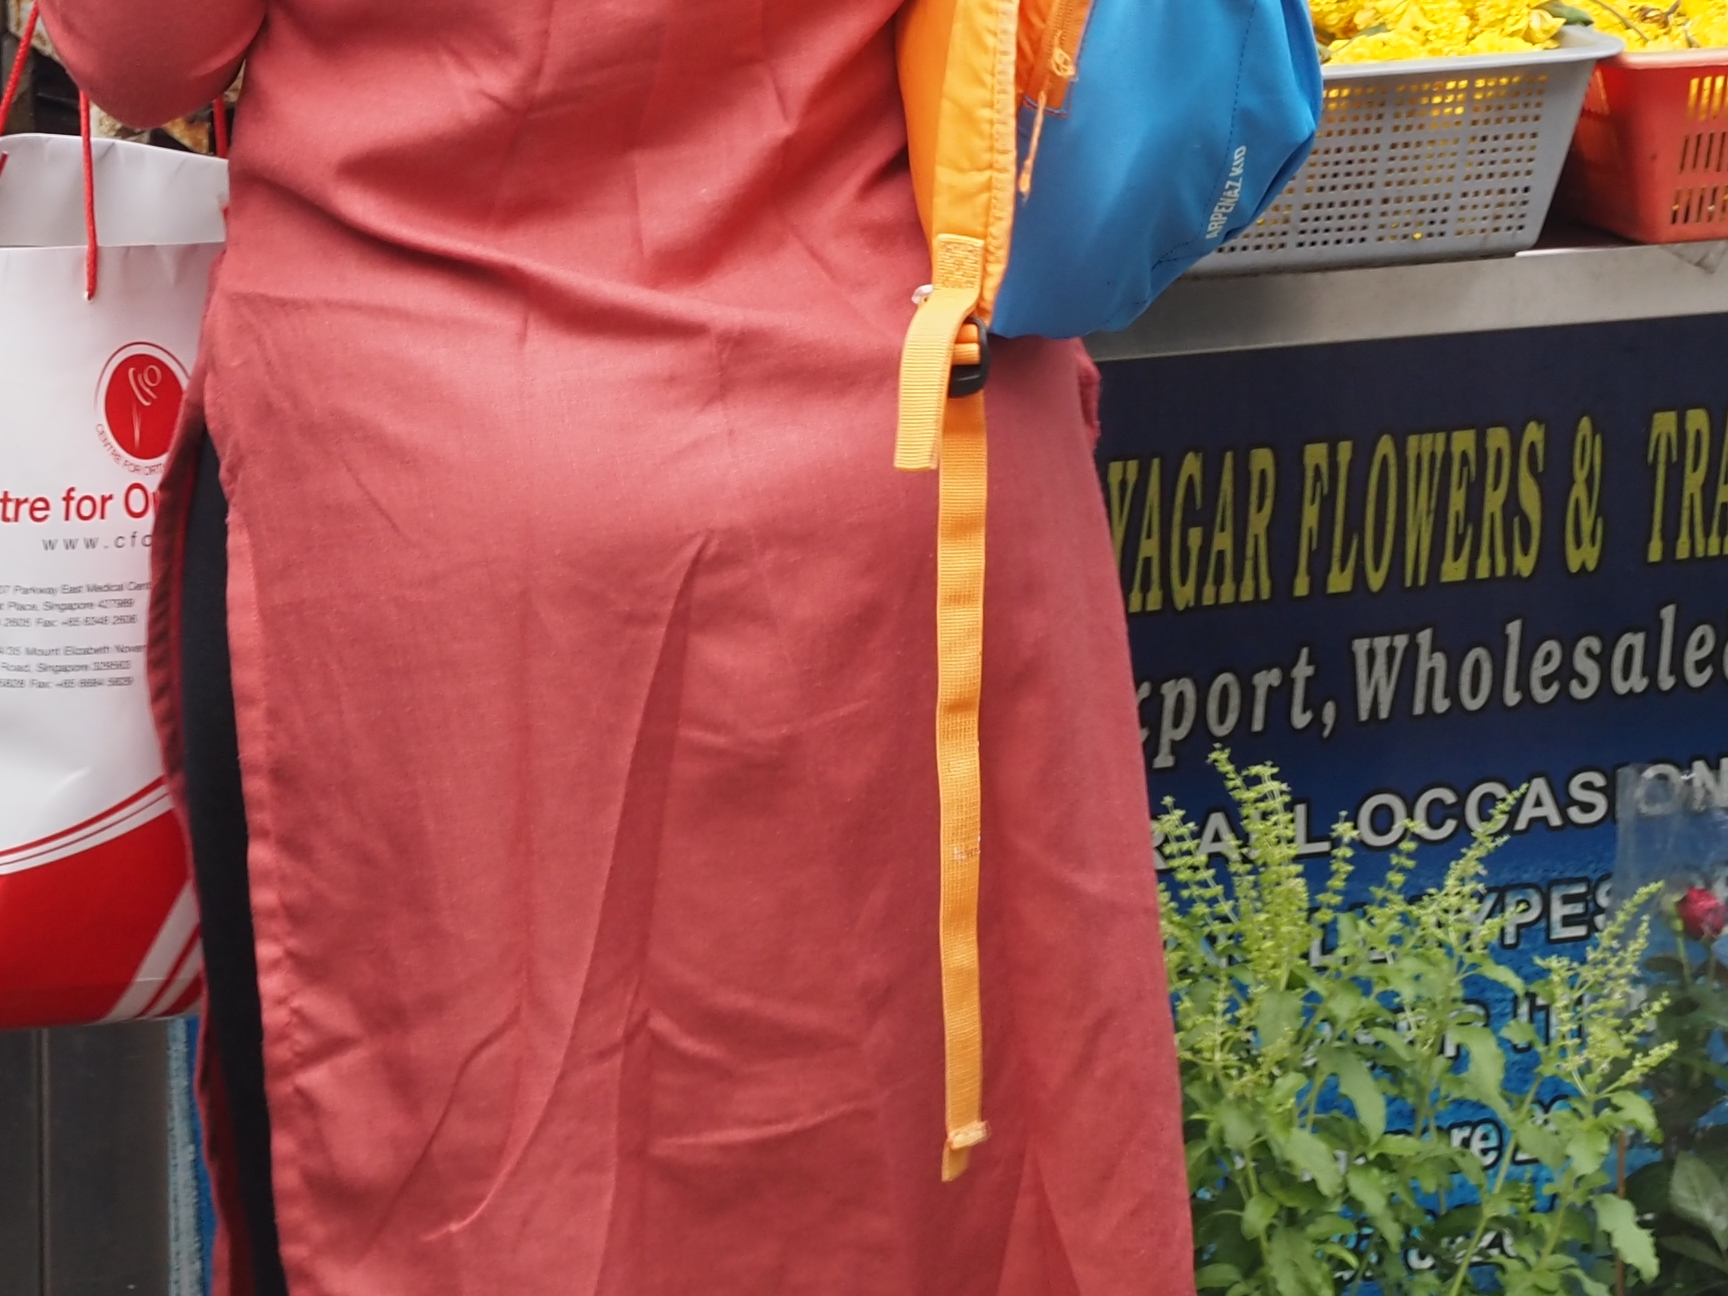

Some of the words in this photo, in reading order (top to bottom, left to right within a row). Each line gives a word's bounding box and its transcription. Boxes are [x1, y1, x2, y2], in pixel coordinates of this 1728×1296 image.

[1206, 177, 1243, 239] ARPENAZ
[1229, 145, 1247, 177] KID
[62, 487, 113, 522] for
[1293, 417, 1545, 597] FLOWERS
[1564, 416, 1605, 573] &
[14, 585, 58, 597] Parkway
[60, 583, 84, 595] East
[85, 583, 124, 593] Medical
[43, 600, 95, 613] Singapore
[24, 646, 61, 657] Mount
[63, 645, 111, 656] Elizabeth
[35, 662, 90, 675] Singapore
[1197, 802, 1332, 861] AL
